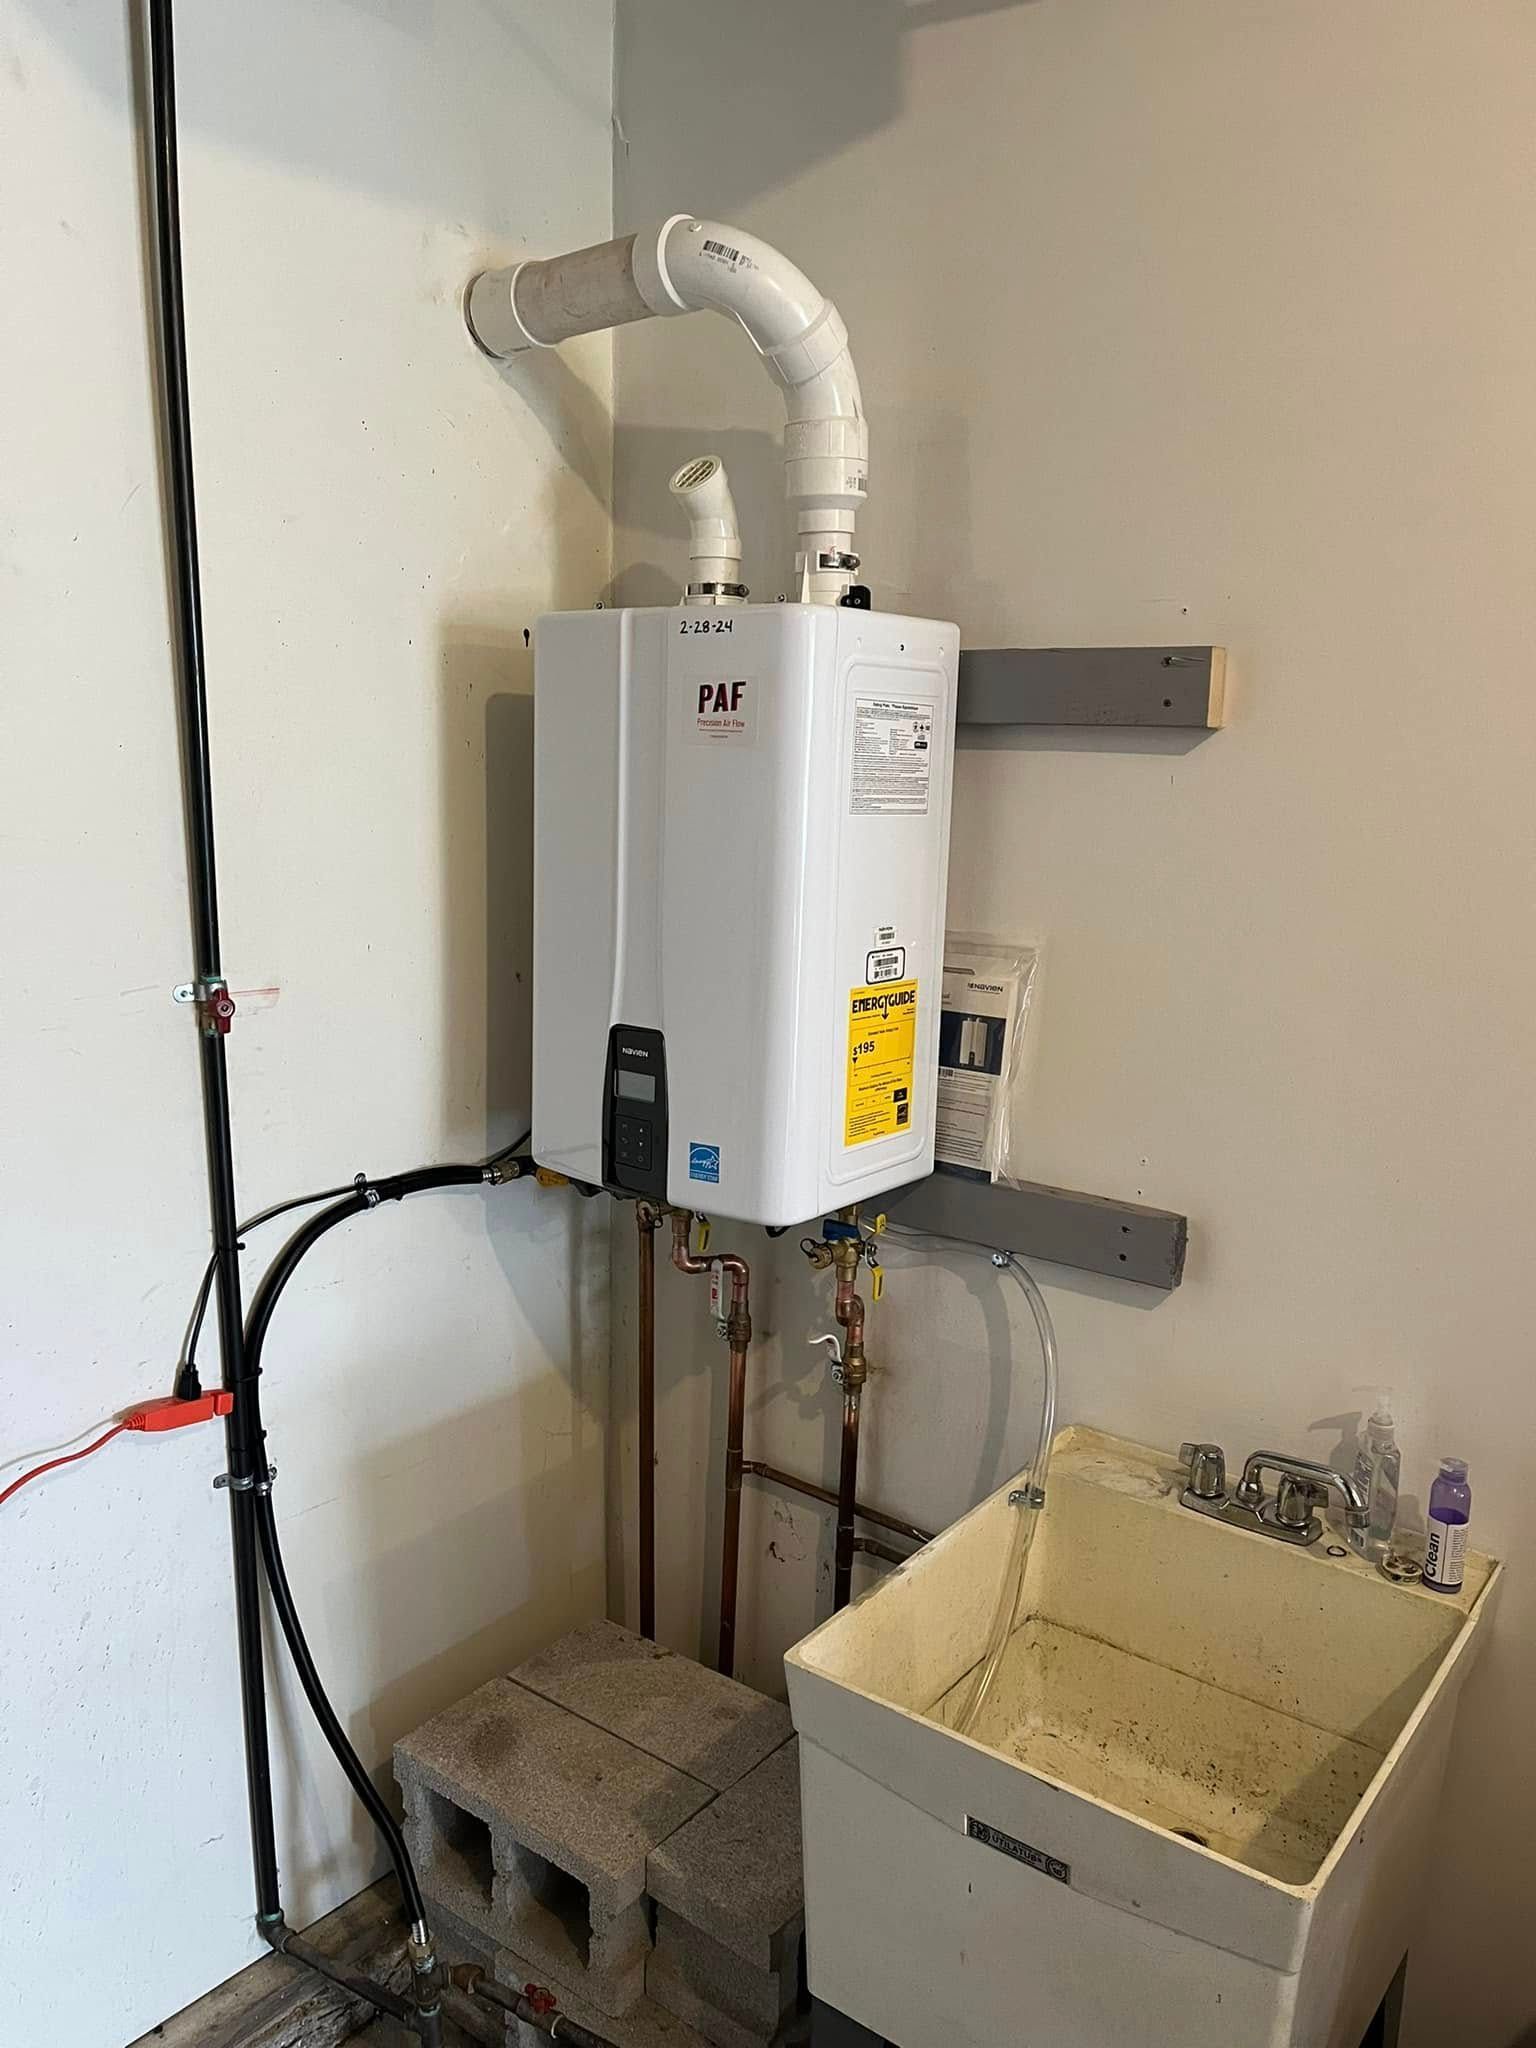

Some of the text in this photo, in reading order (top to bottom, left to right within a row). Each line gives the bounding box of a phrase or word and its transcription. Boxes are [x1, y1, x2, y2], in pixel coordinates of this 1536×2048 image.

[698, 681, 746, 714] PAF
[697, 718, 745, 728] Precision Air Flow
[853, 1041, 875, 1056] $195
[1424, 1533, 1441, 1578] Clean
